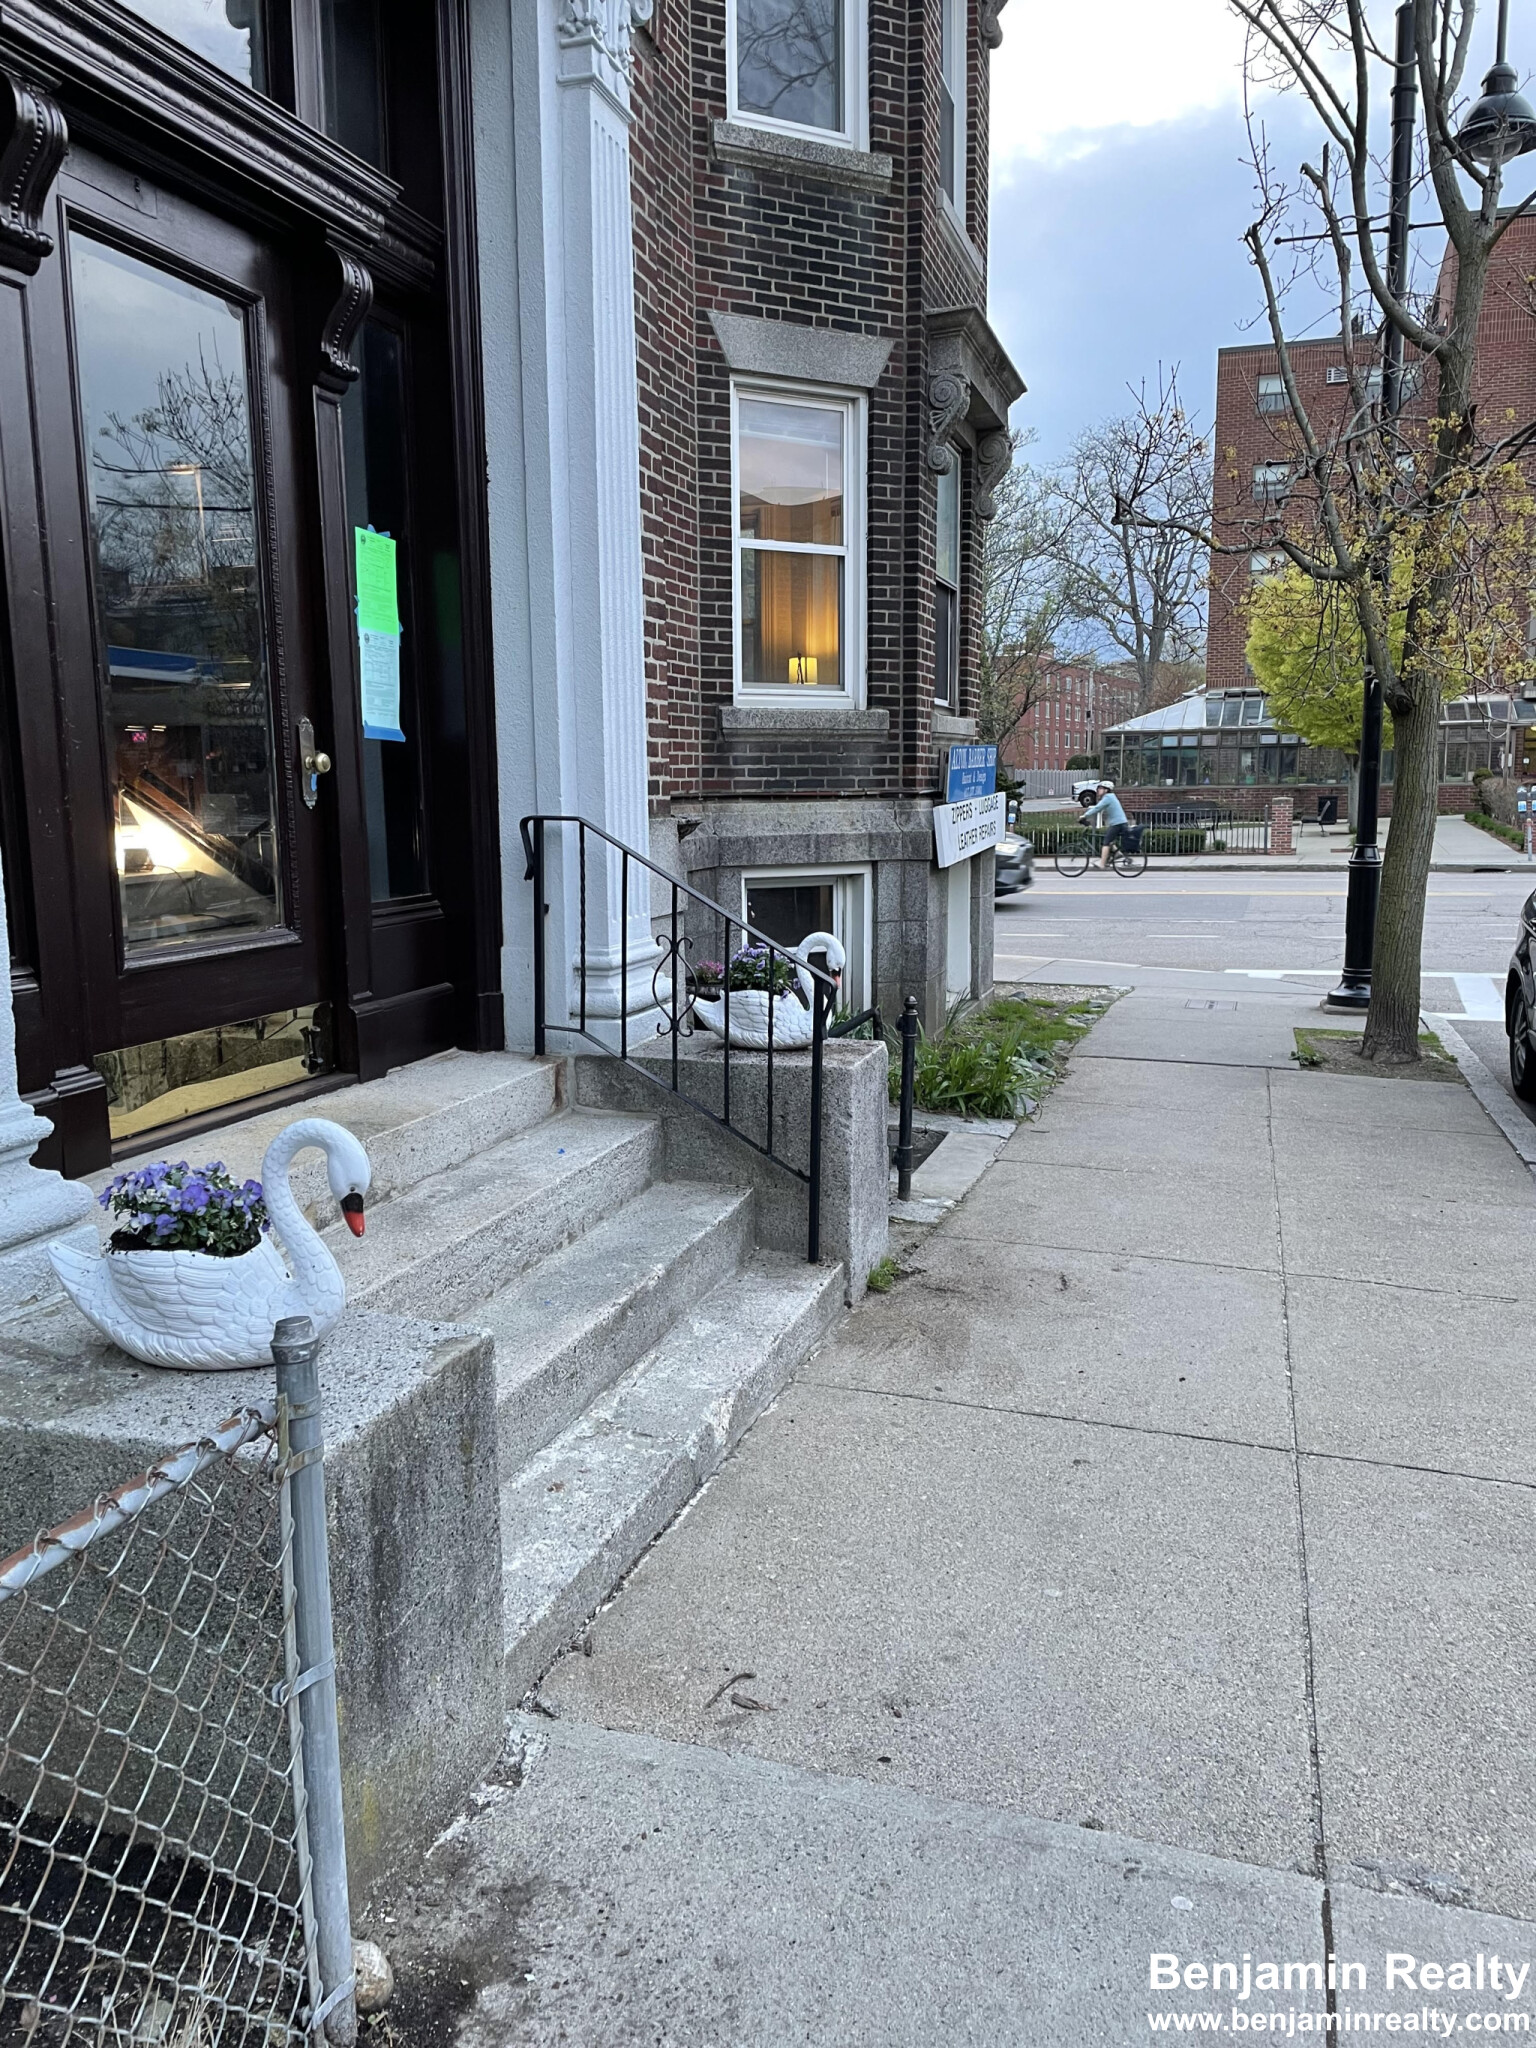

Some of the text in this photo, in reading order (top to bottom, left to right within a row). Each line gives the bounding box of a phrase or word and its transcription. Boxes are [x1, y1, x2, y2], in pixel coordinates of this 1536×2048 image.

[951, 802, 973, 824] ZIPPERS
[978, 795, 999, 815] LUGGAGE
[958, 820, 997, 851] LEATHER REPAIRS
